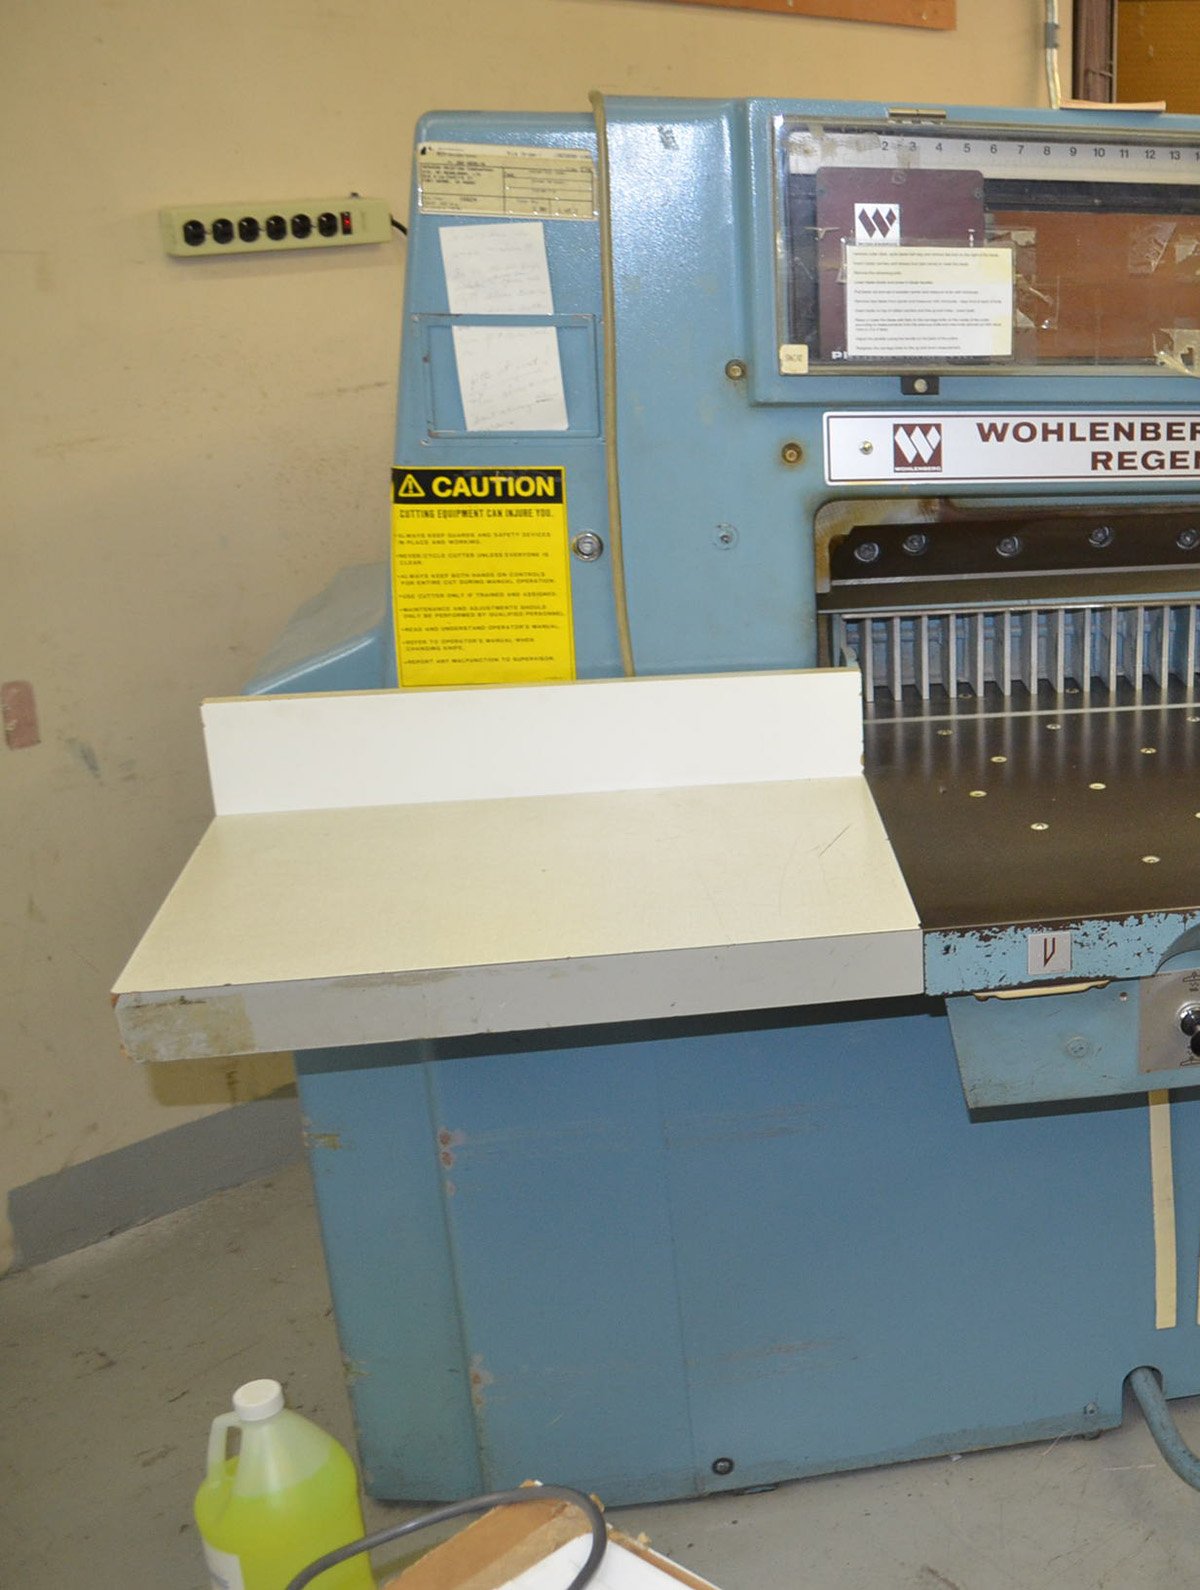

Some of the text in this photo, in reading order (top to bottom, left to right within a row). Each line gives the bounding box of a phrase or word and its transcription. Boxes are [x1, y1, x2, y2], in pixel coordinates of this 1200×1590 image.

[882, 141, 888, 150] 2
[910, 142, 916, 151] 3
[936, 142, 942, 151] 4
[963, 143, 970, 152] 5
[990, 144, 998, 153] 6
[1017, 146, 1024, 155] 7
[1044, 146, 1051, 156] 8
[1069, 147, 1076, 156] 9
[1094, 147, 1105, 157] 10
[1120, 149, 1129, 158] 11
[1145, 150, 1155, 159] 12
[1170, 151, 1181, 160] 13
[431, 476, 555, 497] CAUTION
[400, 509, 553, 518] CUTTING EQUIPMENT CAN INJURE YOU.
